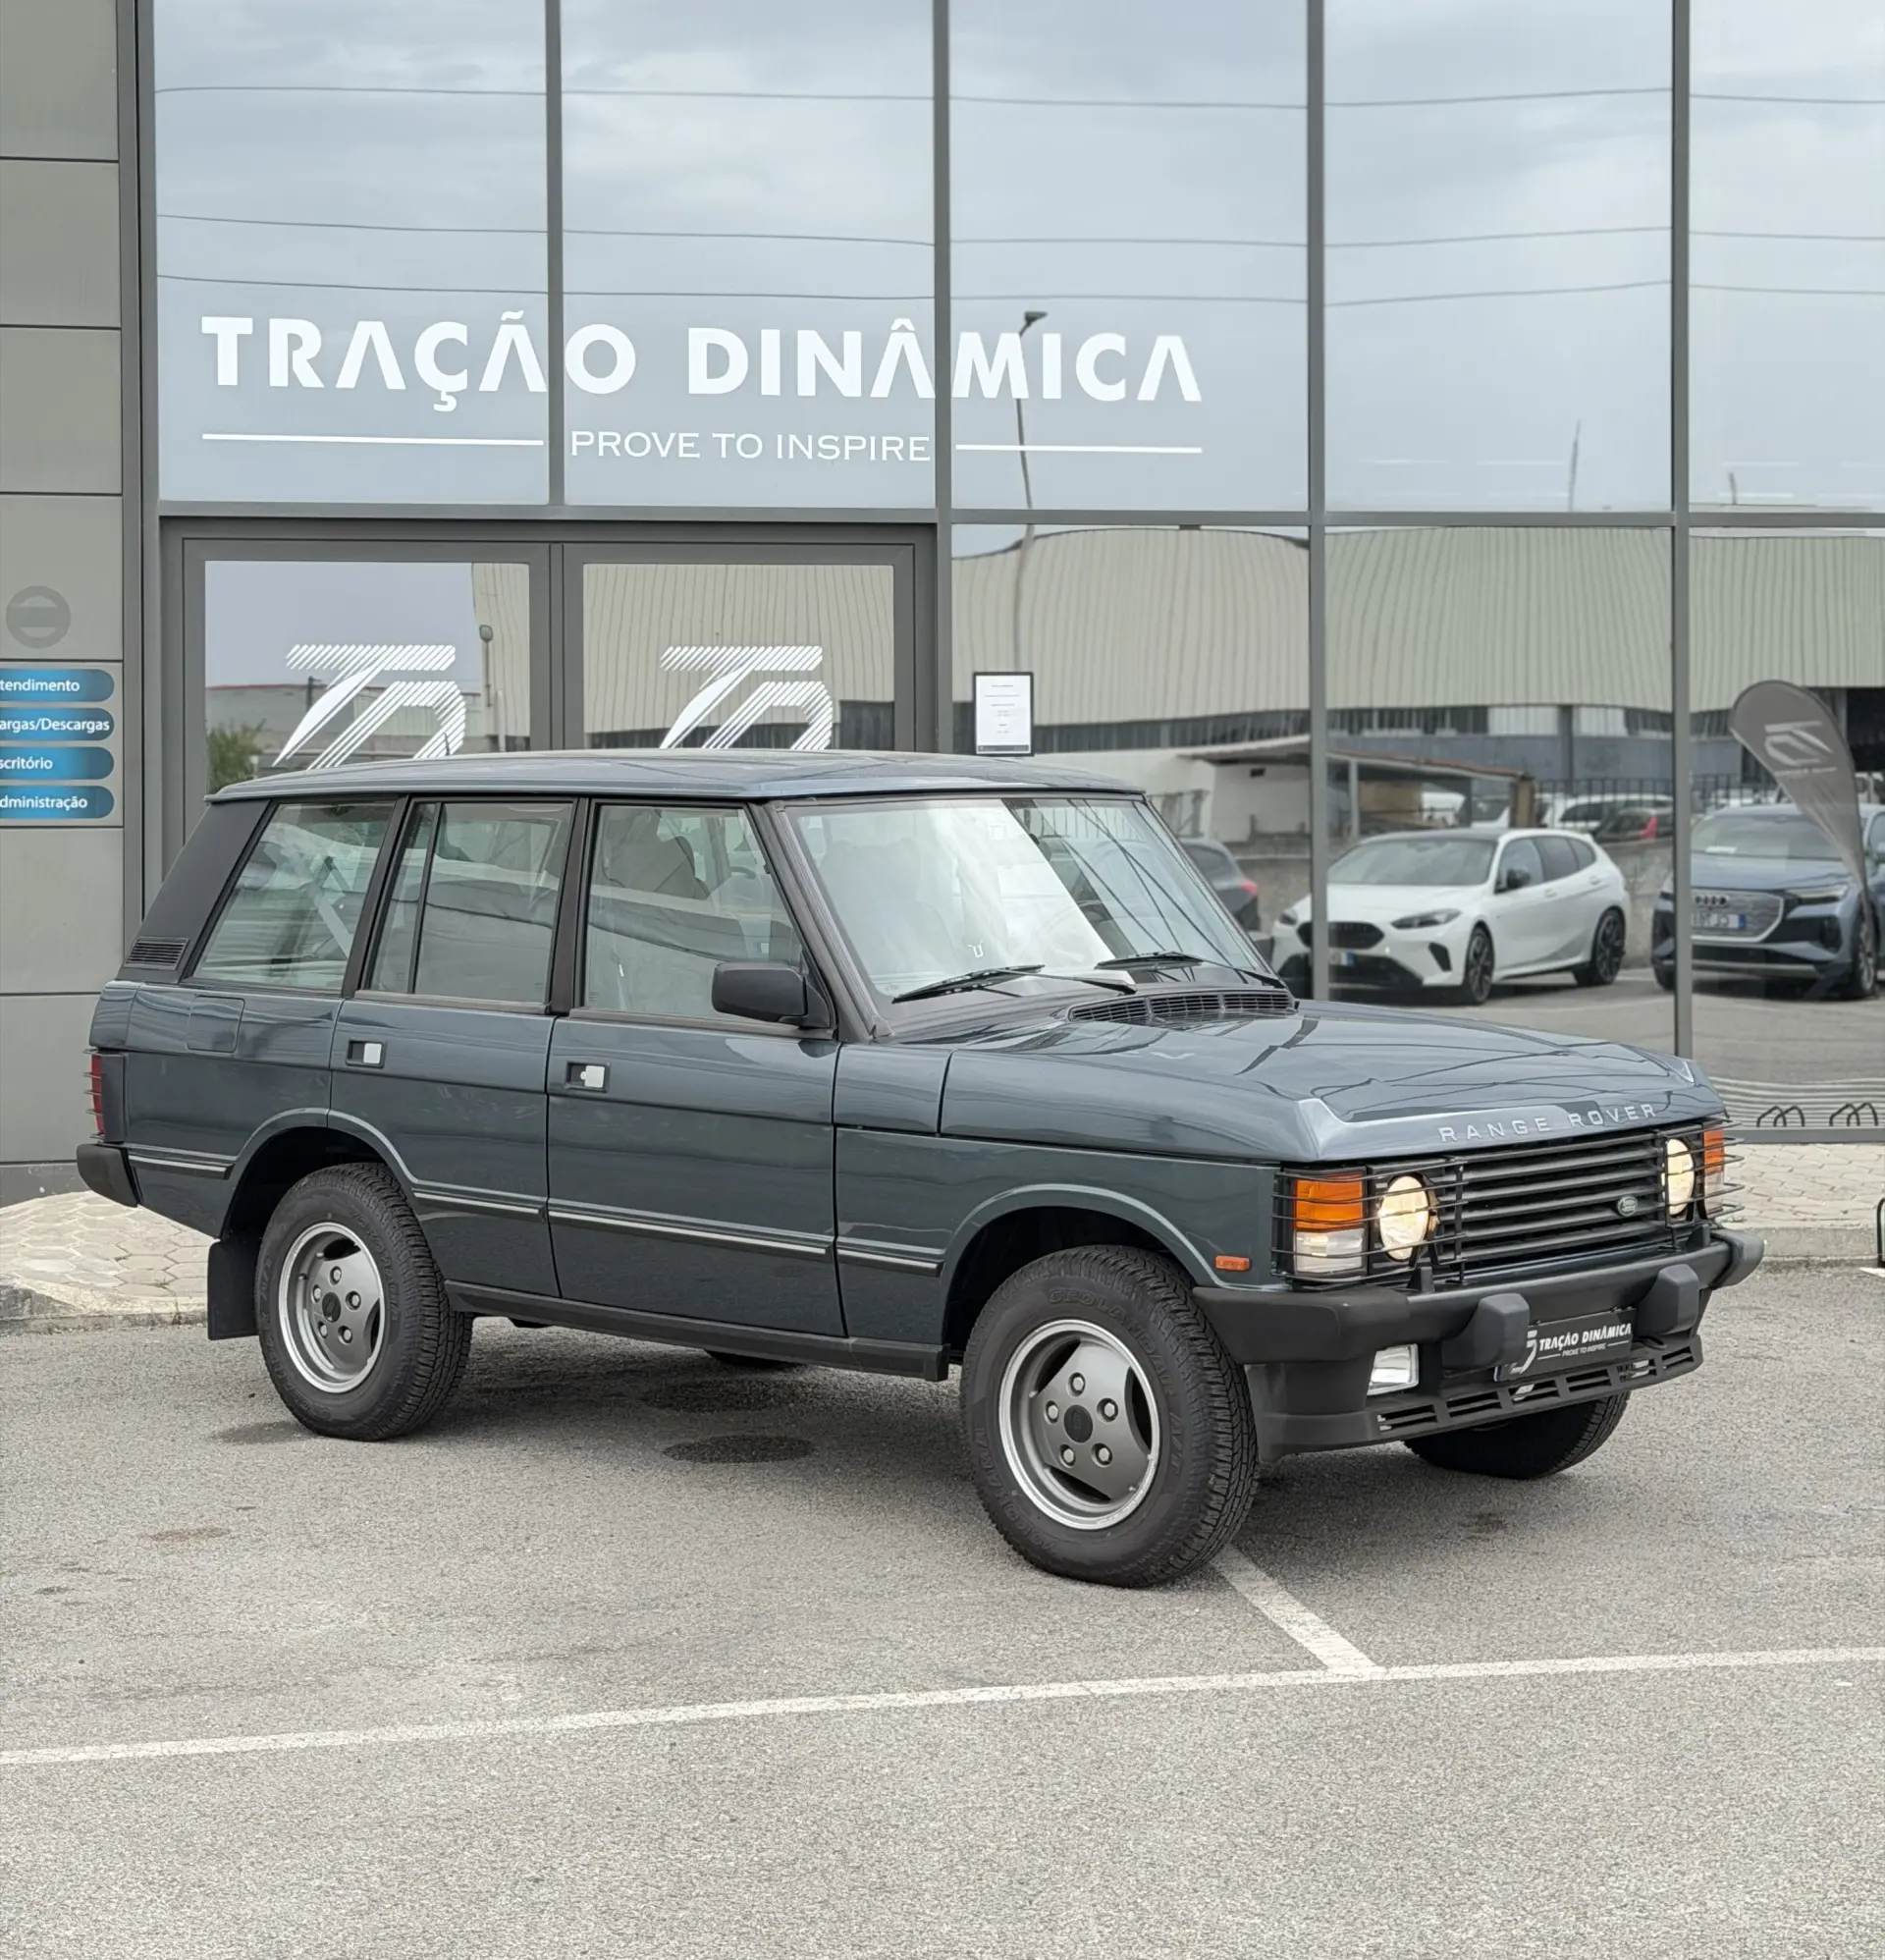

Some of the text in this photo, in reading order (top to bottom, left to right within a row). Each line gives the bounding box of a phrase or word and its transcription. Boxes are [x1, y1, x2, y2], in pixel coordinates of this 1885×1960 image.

[201, 309, 1203, 412] TRAÇÃO DINÂMICA
[570, 430, 931, 463] PROVE TO INSPIRE
[0, 678, 81, 692] tendimento
[0, 717, 110, 735] argas/Descargas
[0, 794, 87, 811] dministração
[1438, 1103, 1657, 1143] RANGE ROVER
